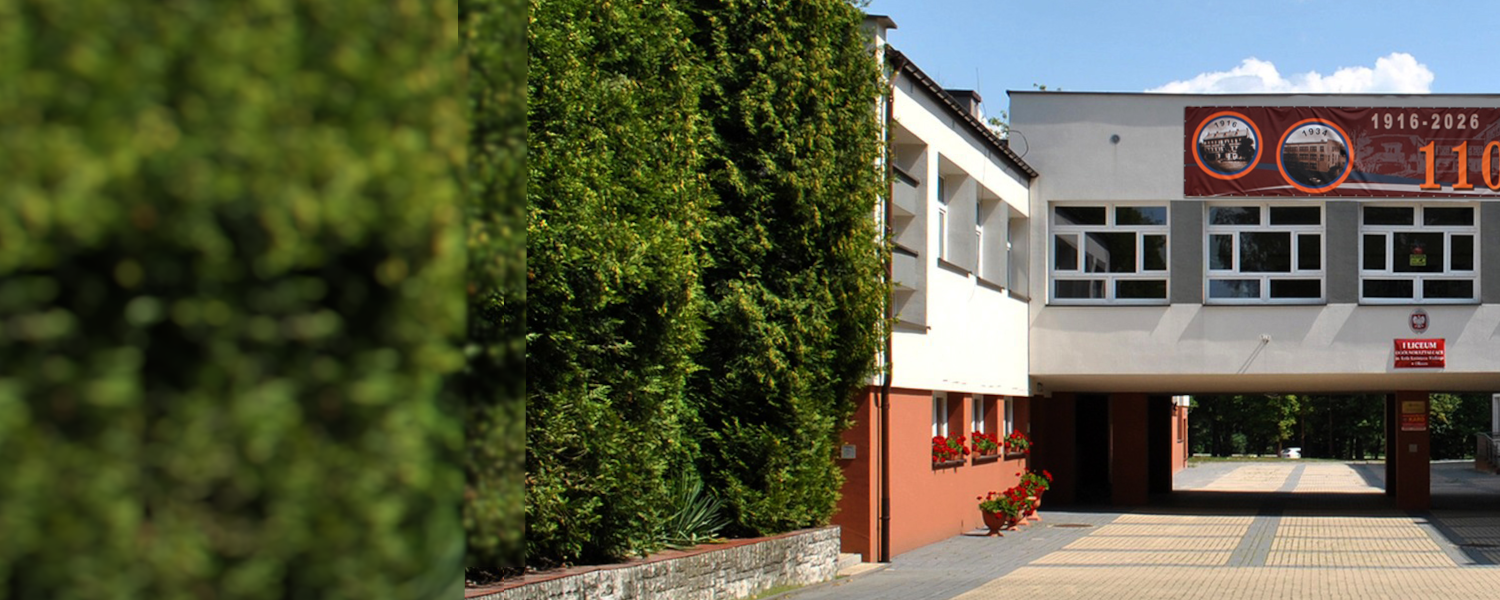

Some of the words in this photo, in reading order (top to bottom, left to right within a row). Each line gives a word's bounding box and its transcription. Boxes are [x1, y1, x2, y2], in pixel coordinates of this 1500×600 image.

[1214, 120, 1237, 128] 1916
[1371, 113, 1480, 130] 1916-2026
[1302, 128, 1328, 137] 1934
